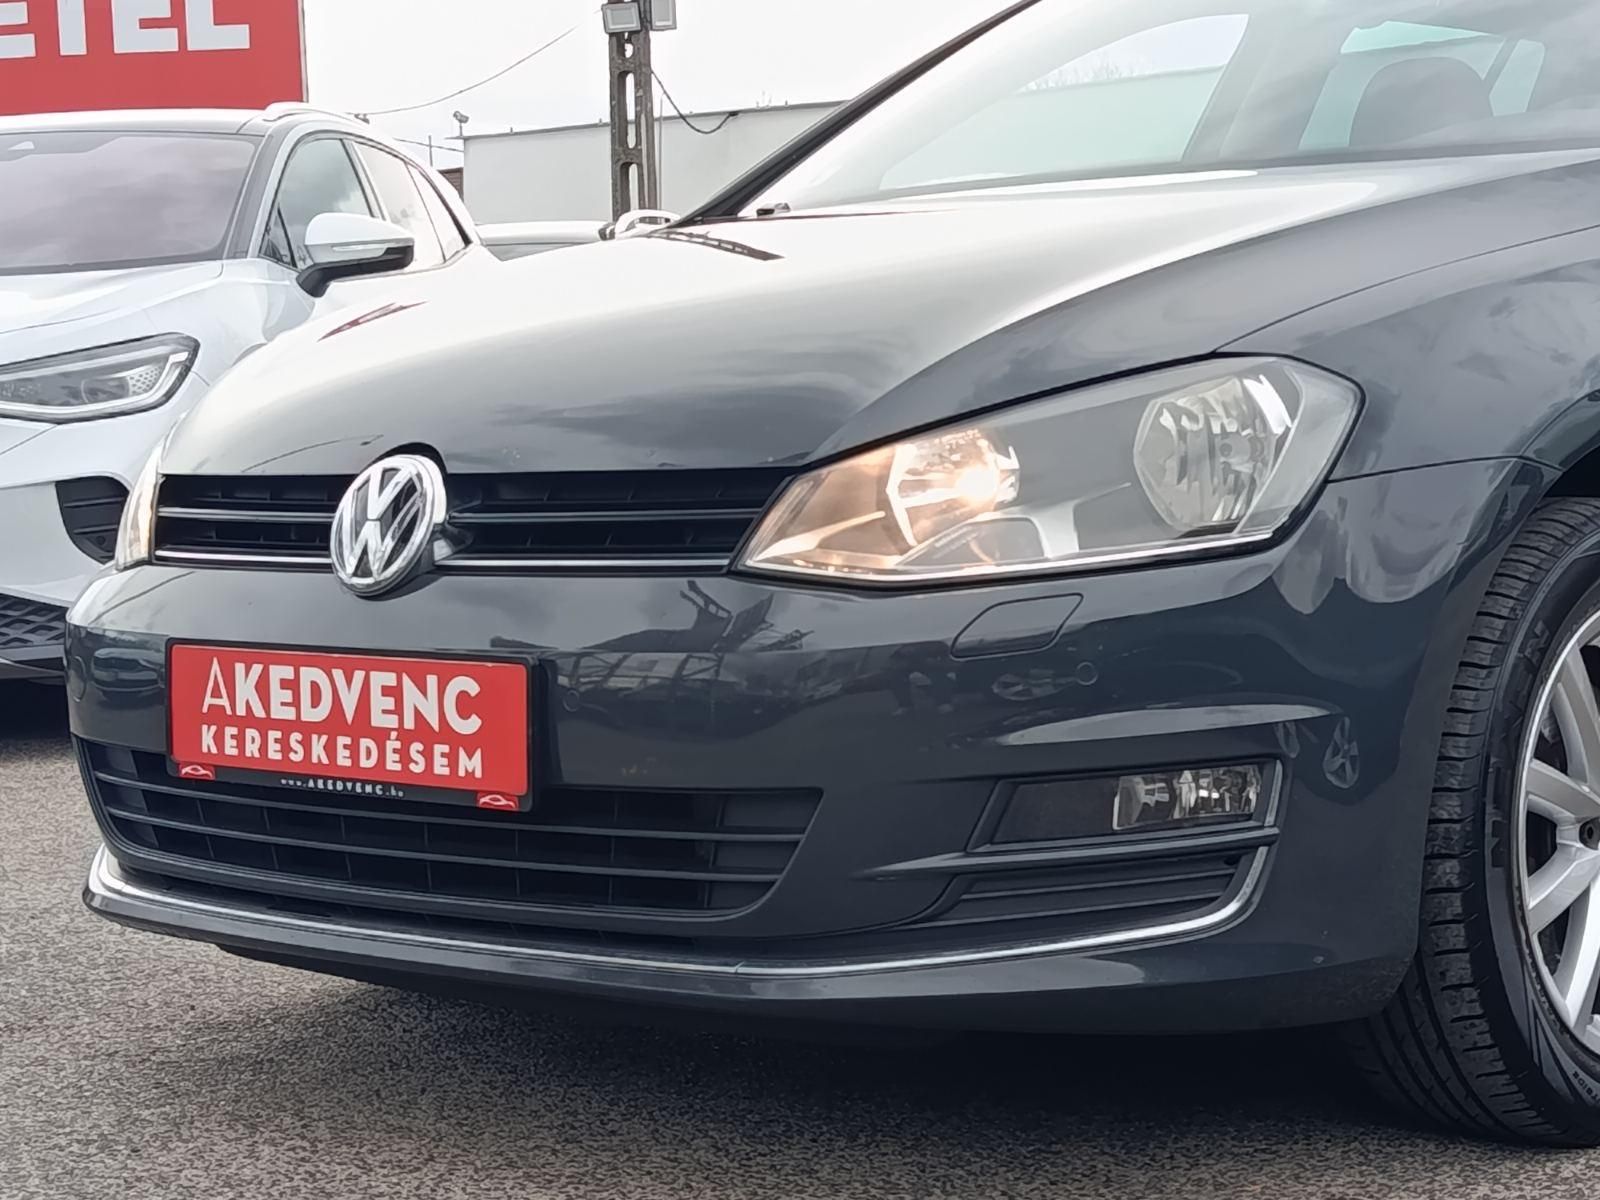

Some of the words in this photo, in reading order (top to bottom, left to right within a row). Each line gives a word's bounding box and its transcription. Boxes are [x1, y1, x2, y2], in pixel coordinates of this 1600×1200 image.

[338, 458, 431, 583] VW
[202, 656, 482, 735] AKEDVENC
[201, 724, 482, 778] KERESKEDÉSEM
